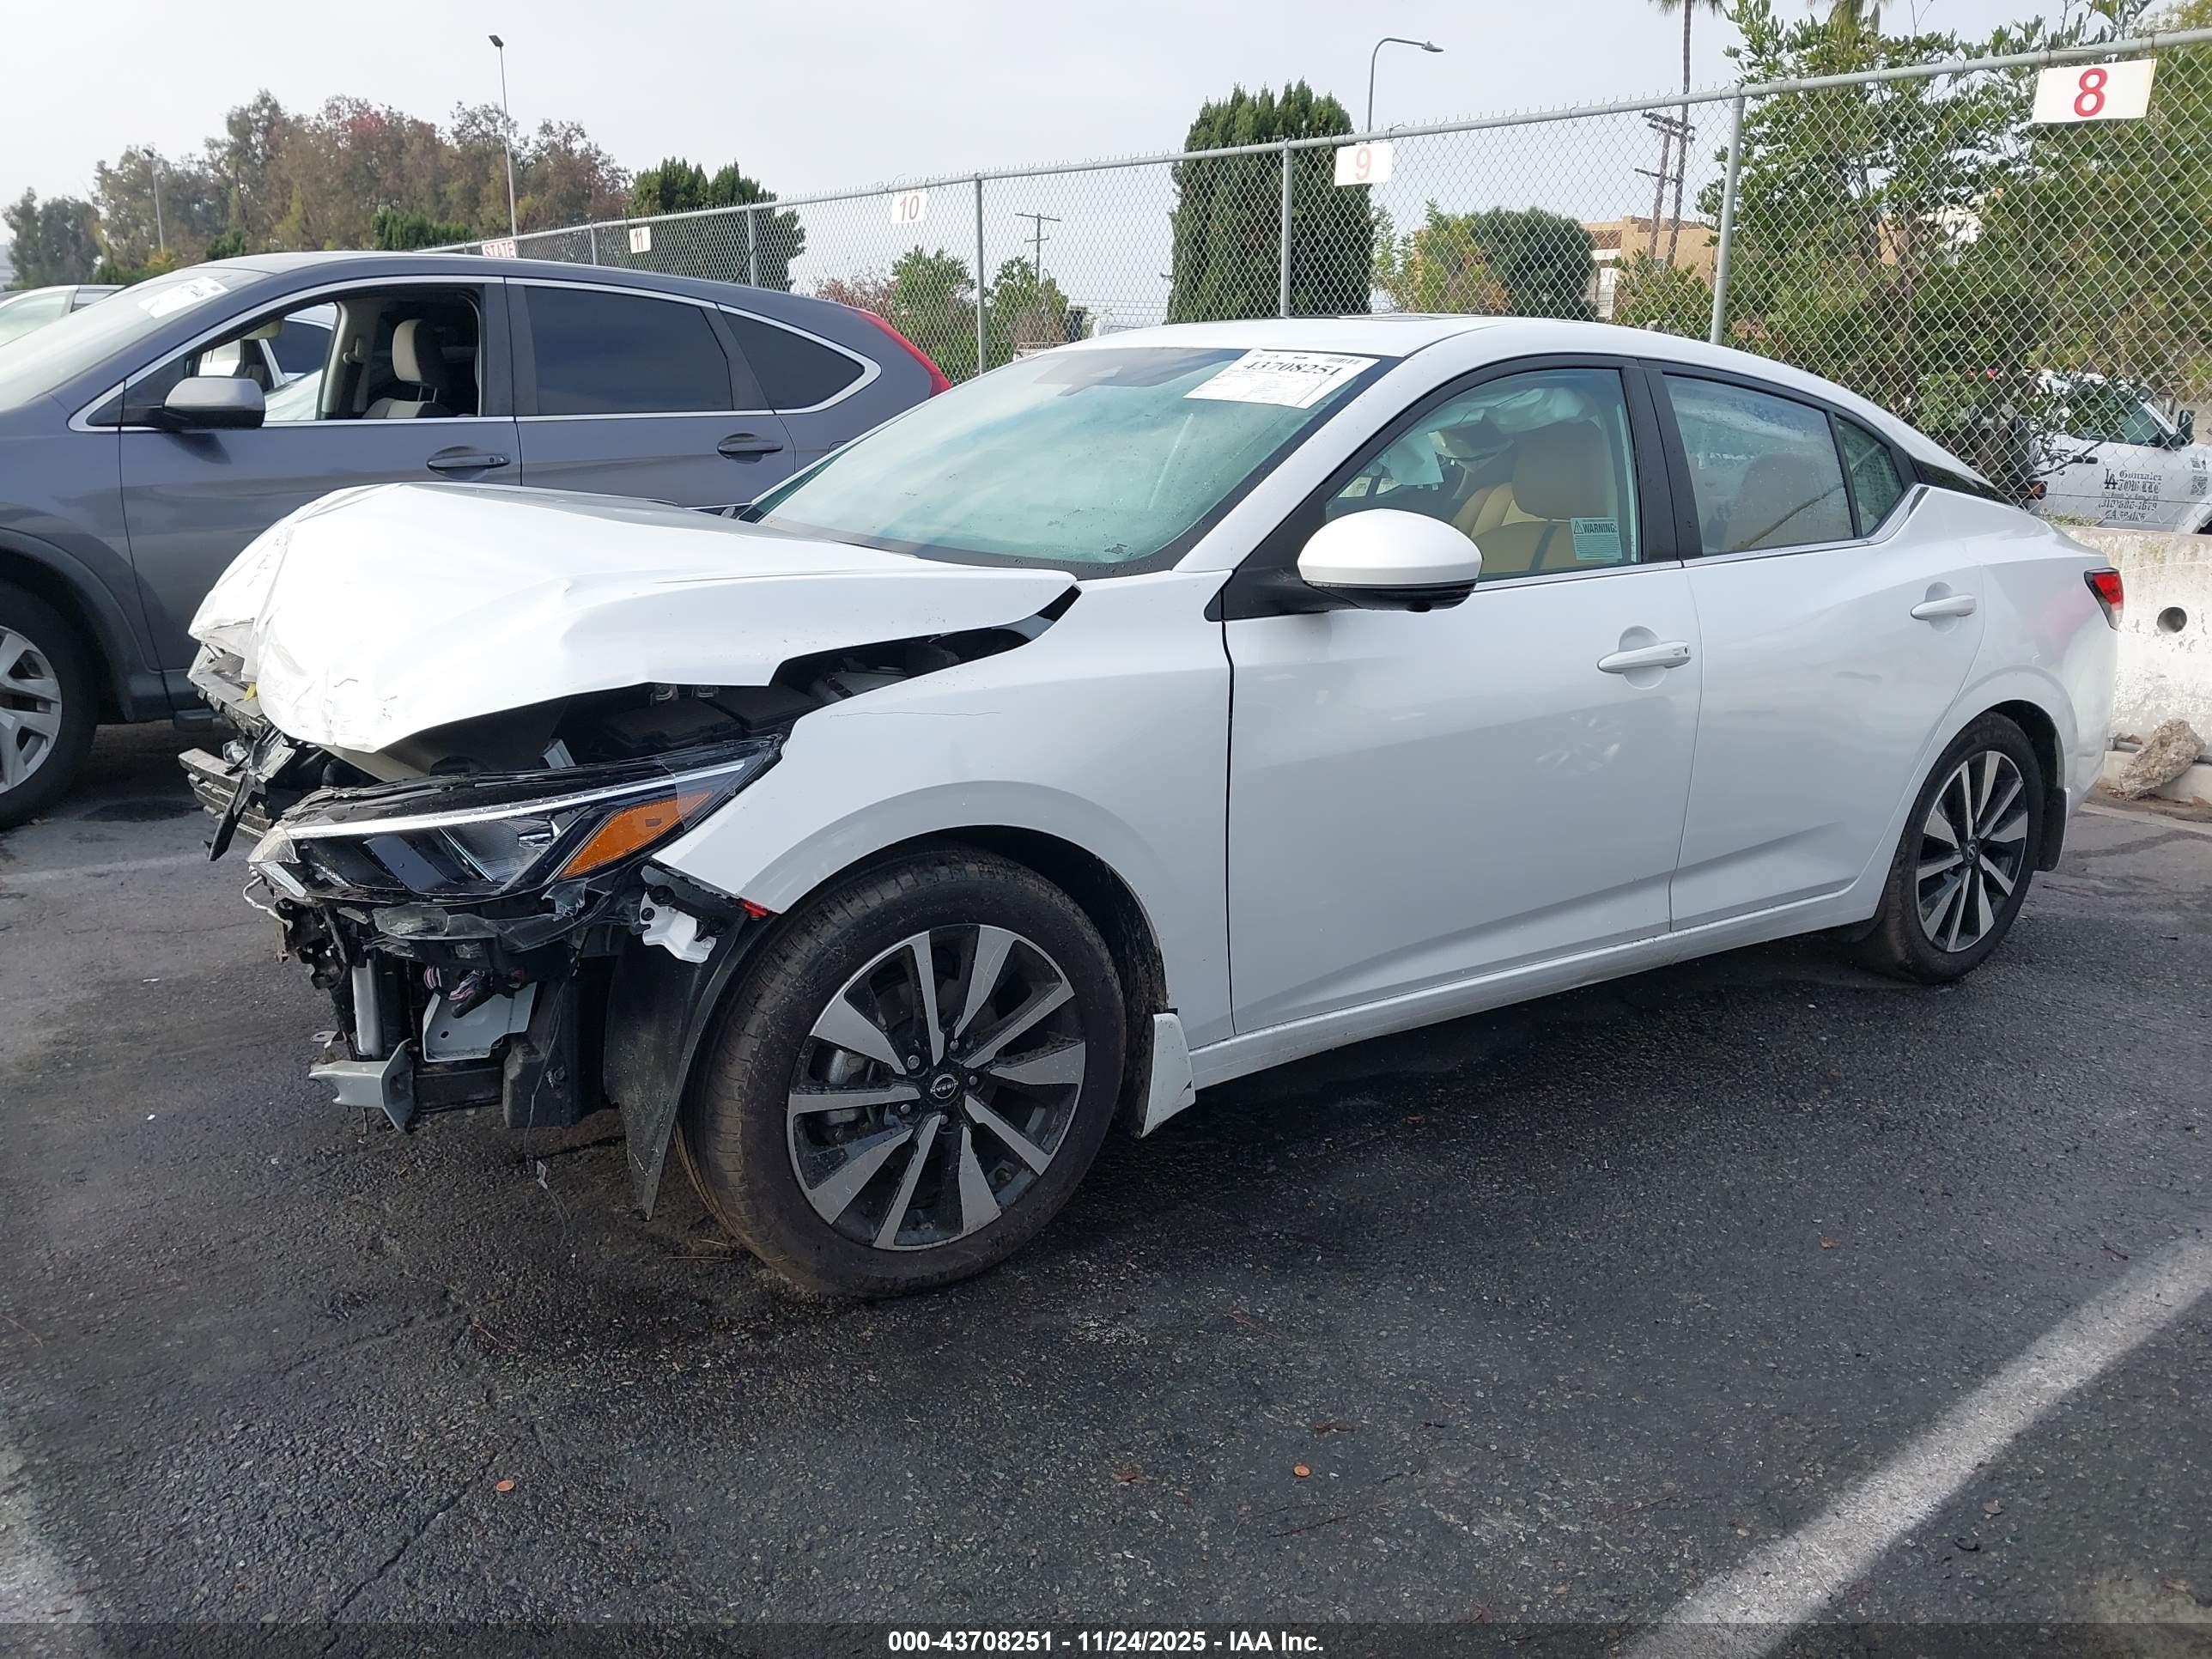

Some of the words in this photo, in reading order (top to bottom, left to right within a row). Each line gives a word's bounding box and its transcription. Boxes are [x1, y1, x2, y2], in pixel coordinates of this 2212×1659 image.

[2074, 68, 2108, 117] 8
[1355, 146, 1372, 180] 9
[899, 195, 920, 222] 10
[485, 241, 514, 258] STATE
[634, 228, 643, 250] 11
[1243, 361, 1343, 376] 43708251
